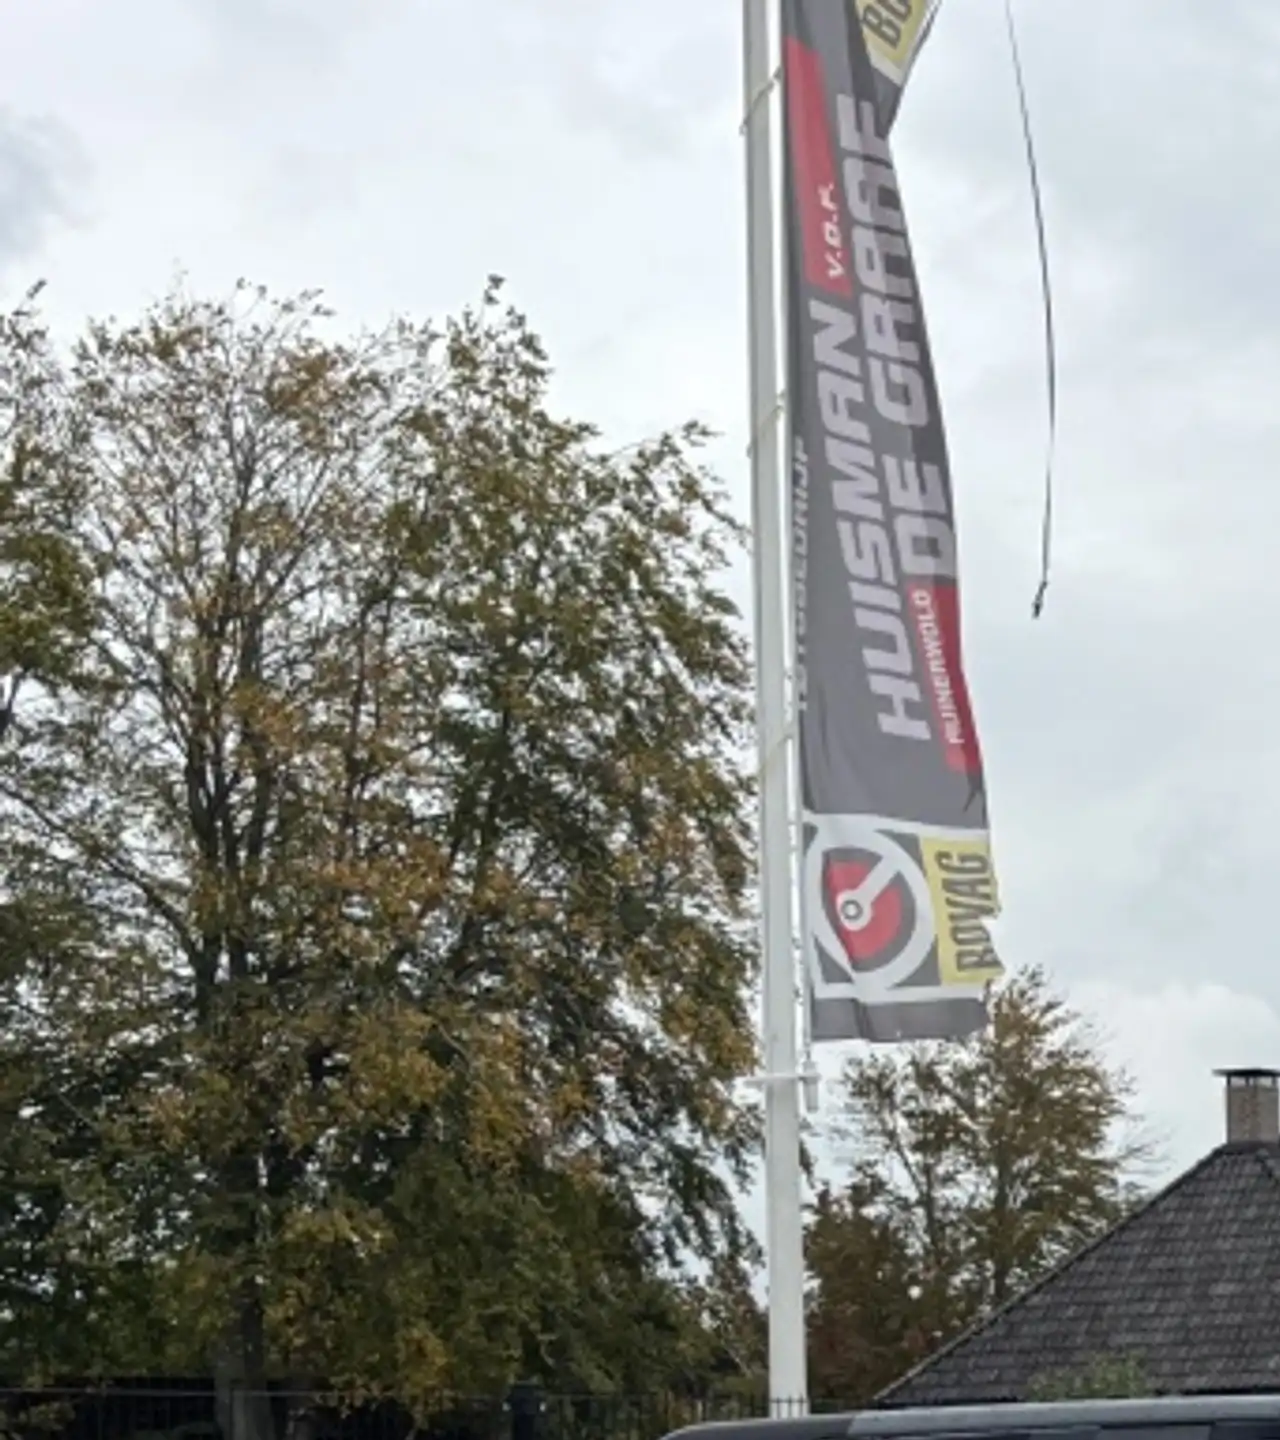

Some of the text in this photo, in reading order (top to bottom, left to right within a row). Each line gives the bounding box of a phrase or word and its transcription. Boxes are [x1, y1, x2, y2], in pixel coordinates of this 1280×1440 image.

[808, 297, 931, 741] HUISMAN
[836, 93, 957, 577] DE GRAAF
